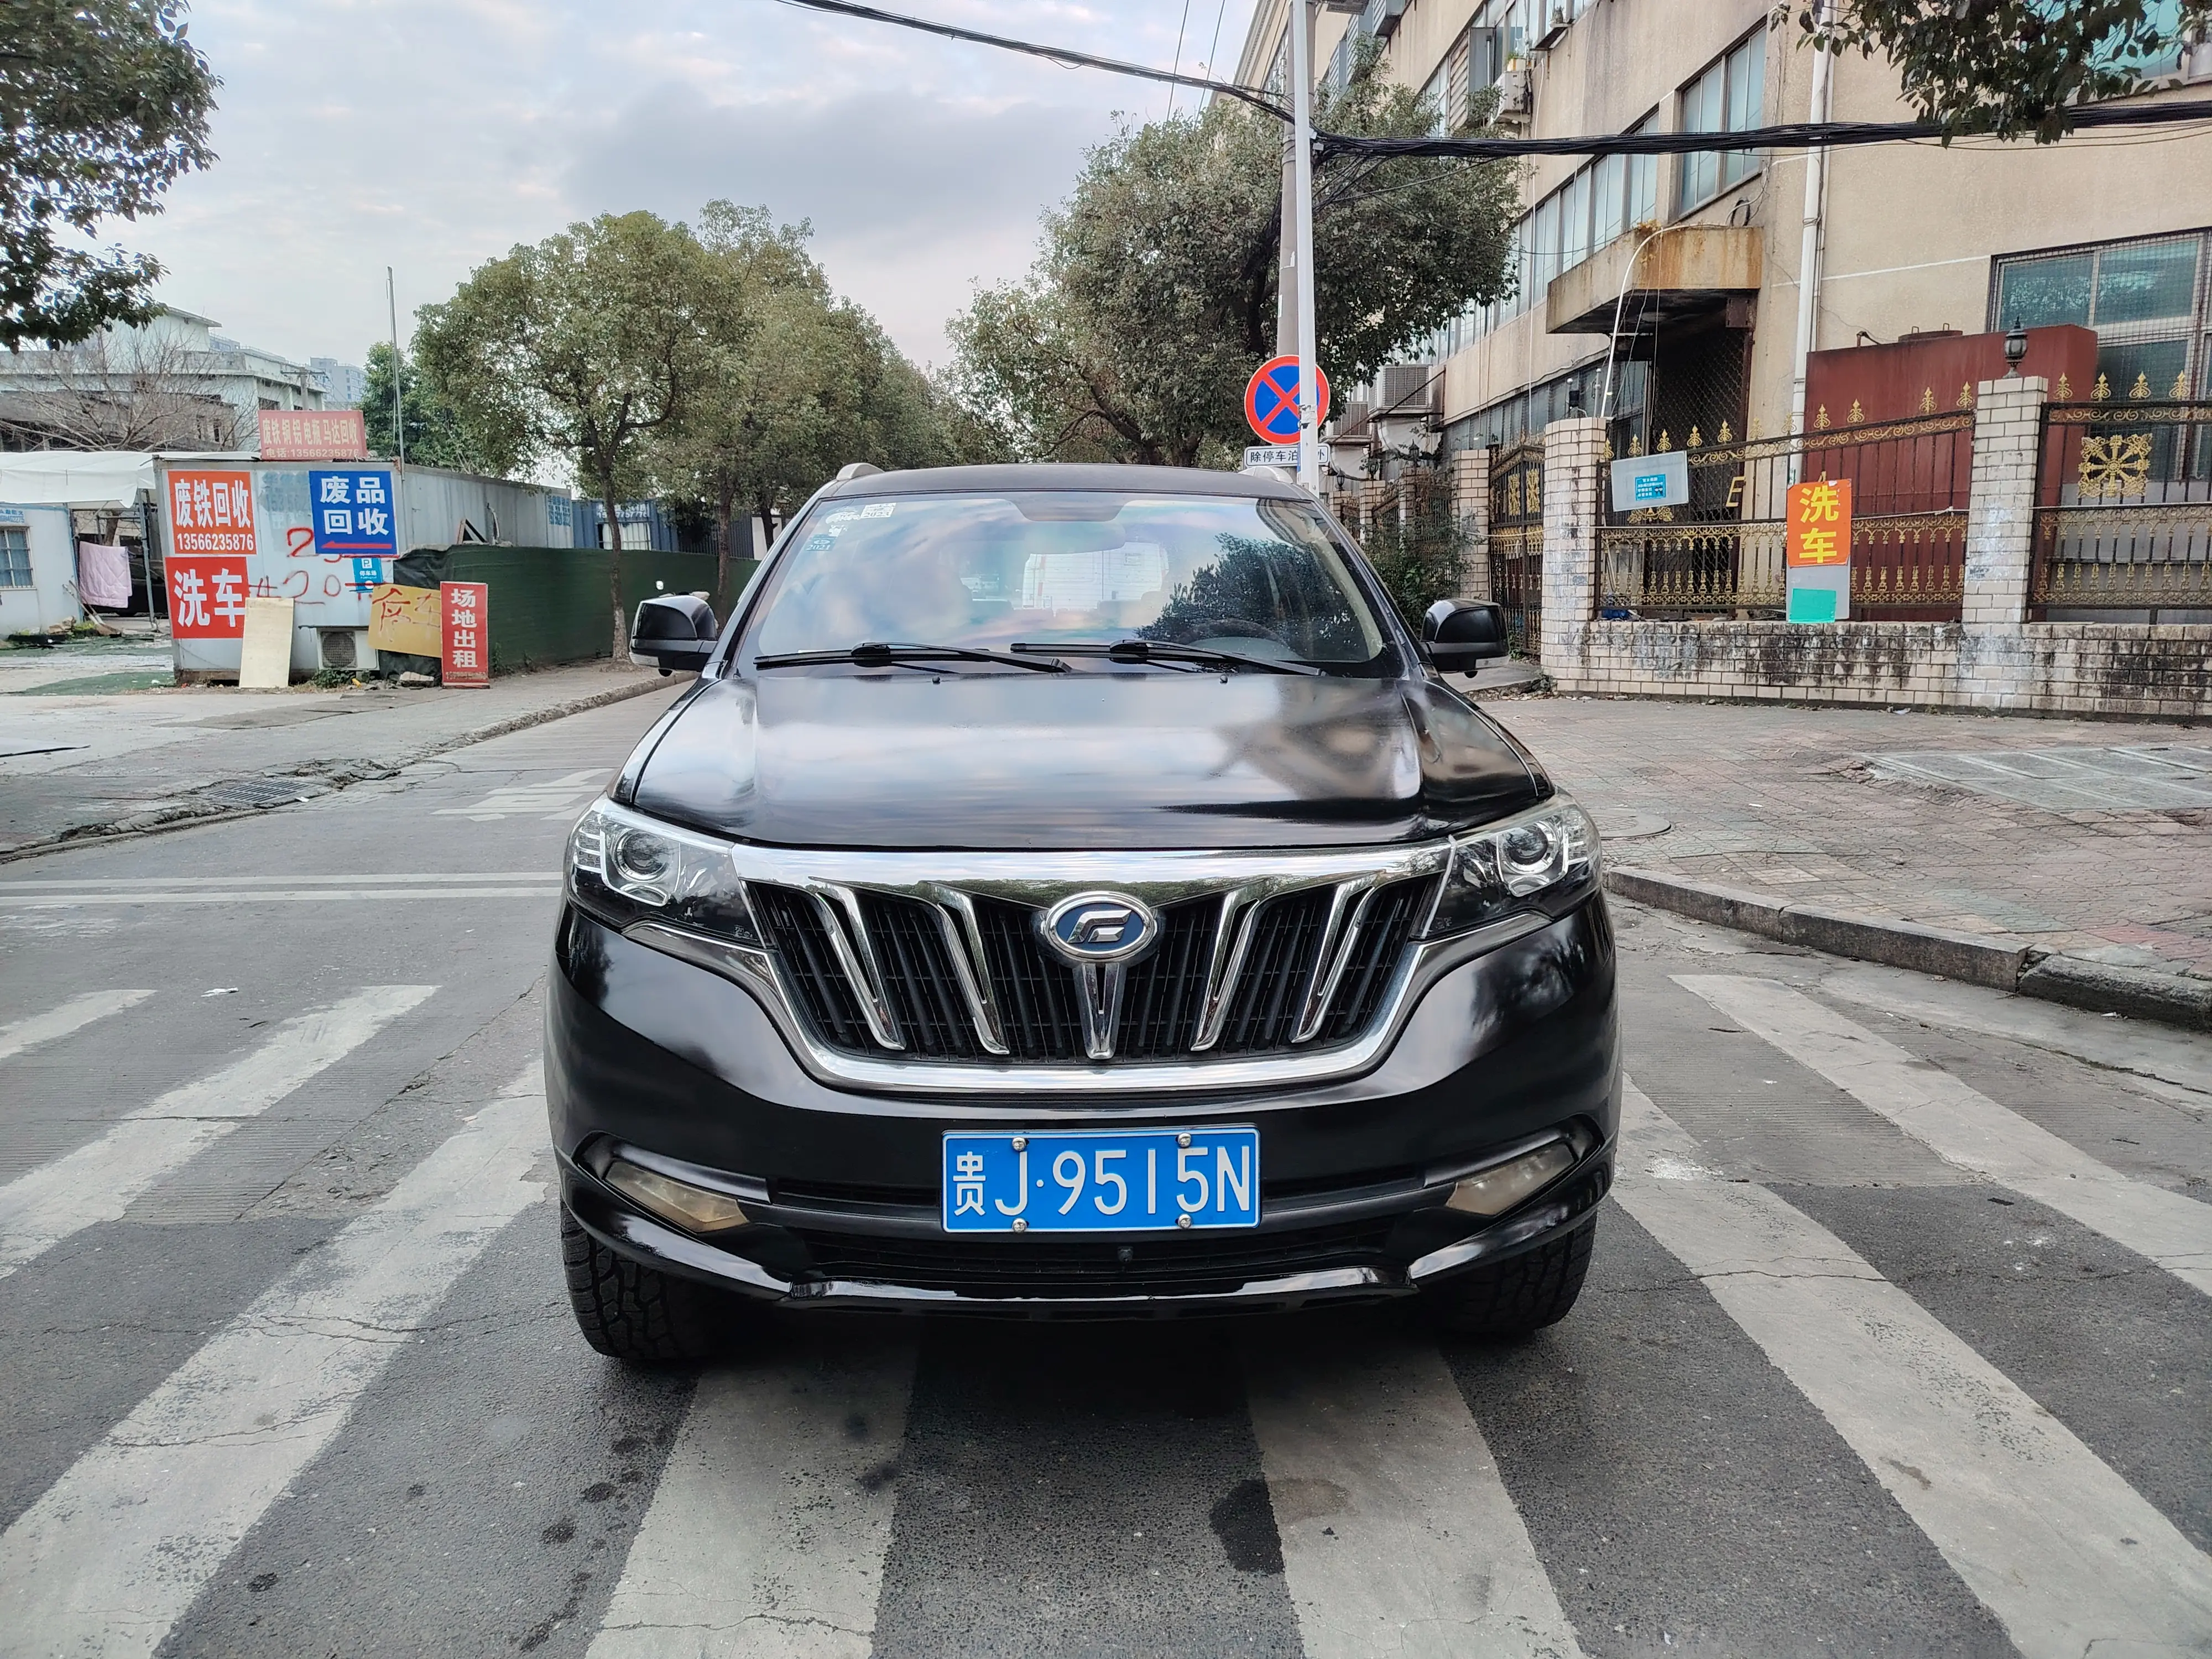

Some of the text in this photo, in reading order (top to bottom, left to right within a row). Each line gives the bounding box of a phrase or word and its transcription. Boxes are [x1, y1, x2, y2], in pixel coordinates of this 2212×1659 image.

[174, 478, 251, 528] 废铁回收
[320, 476, 385, 504] 废品
[177, 533, 254, 551] 13566235876
[324, 508, 389, 535] 回收
[1799, 485, 1839, 564] 洗车
[174, 568, 246, 628] 洗车
[451, 588, 478, 668] 场地出租
